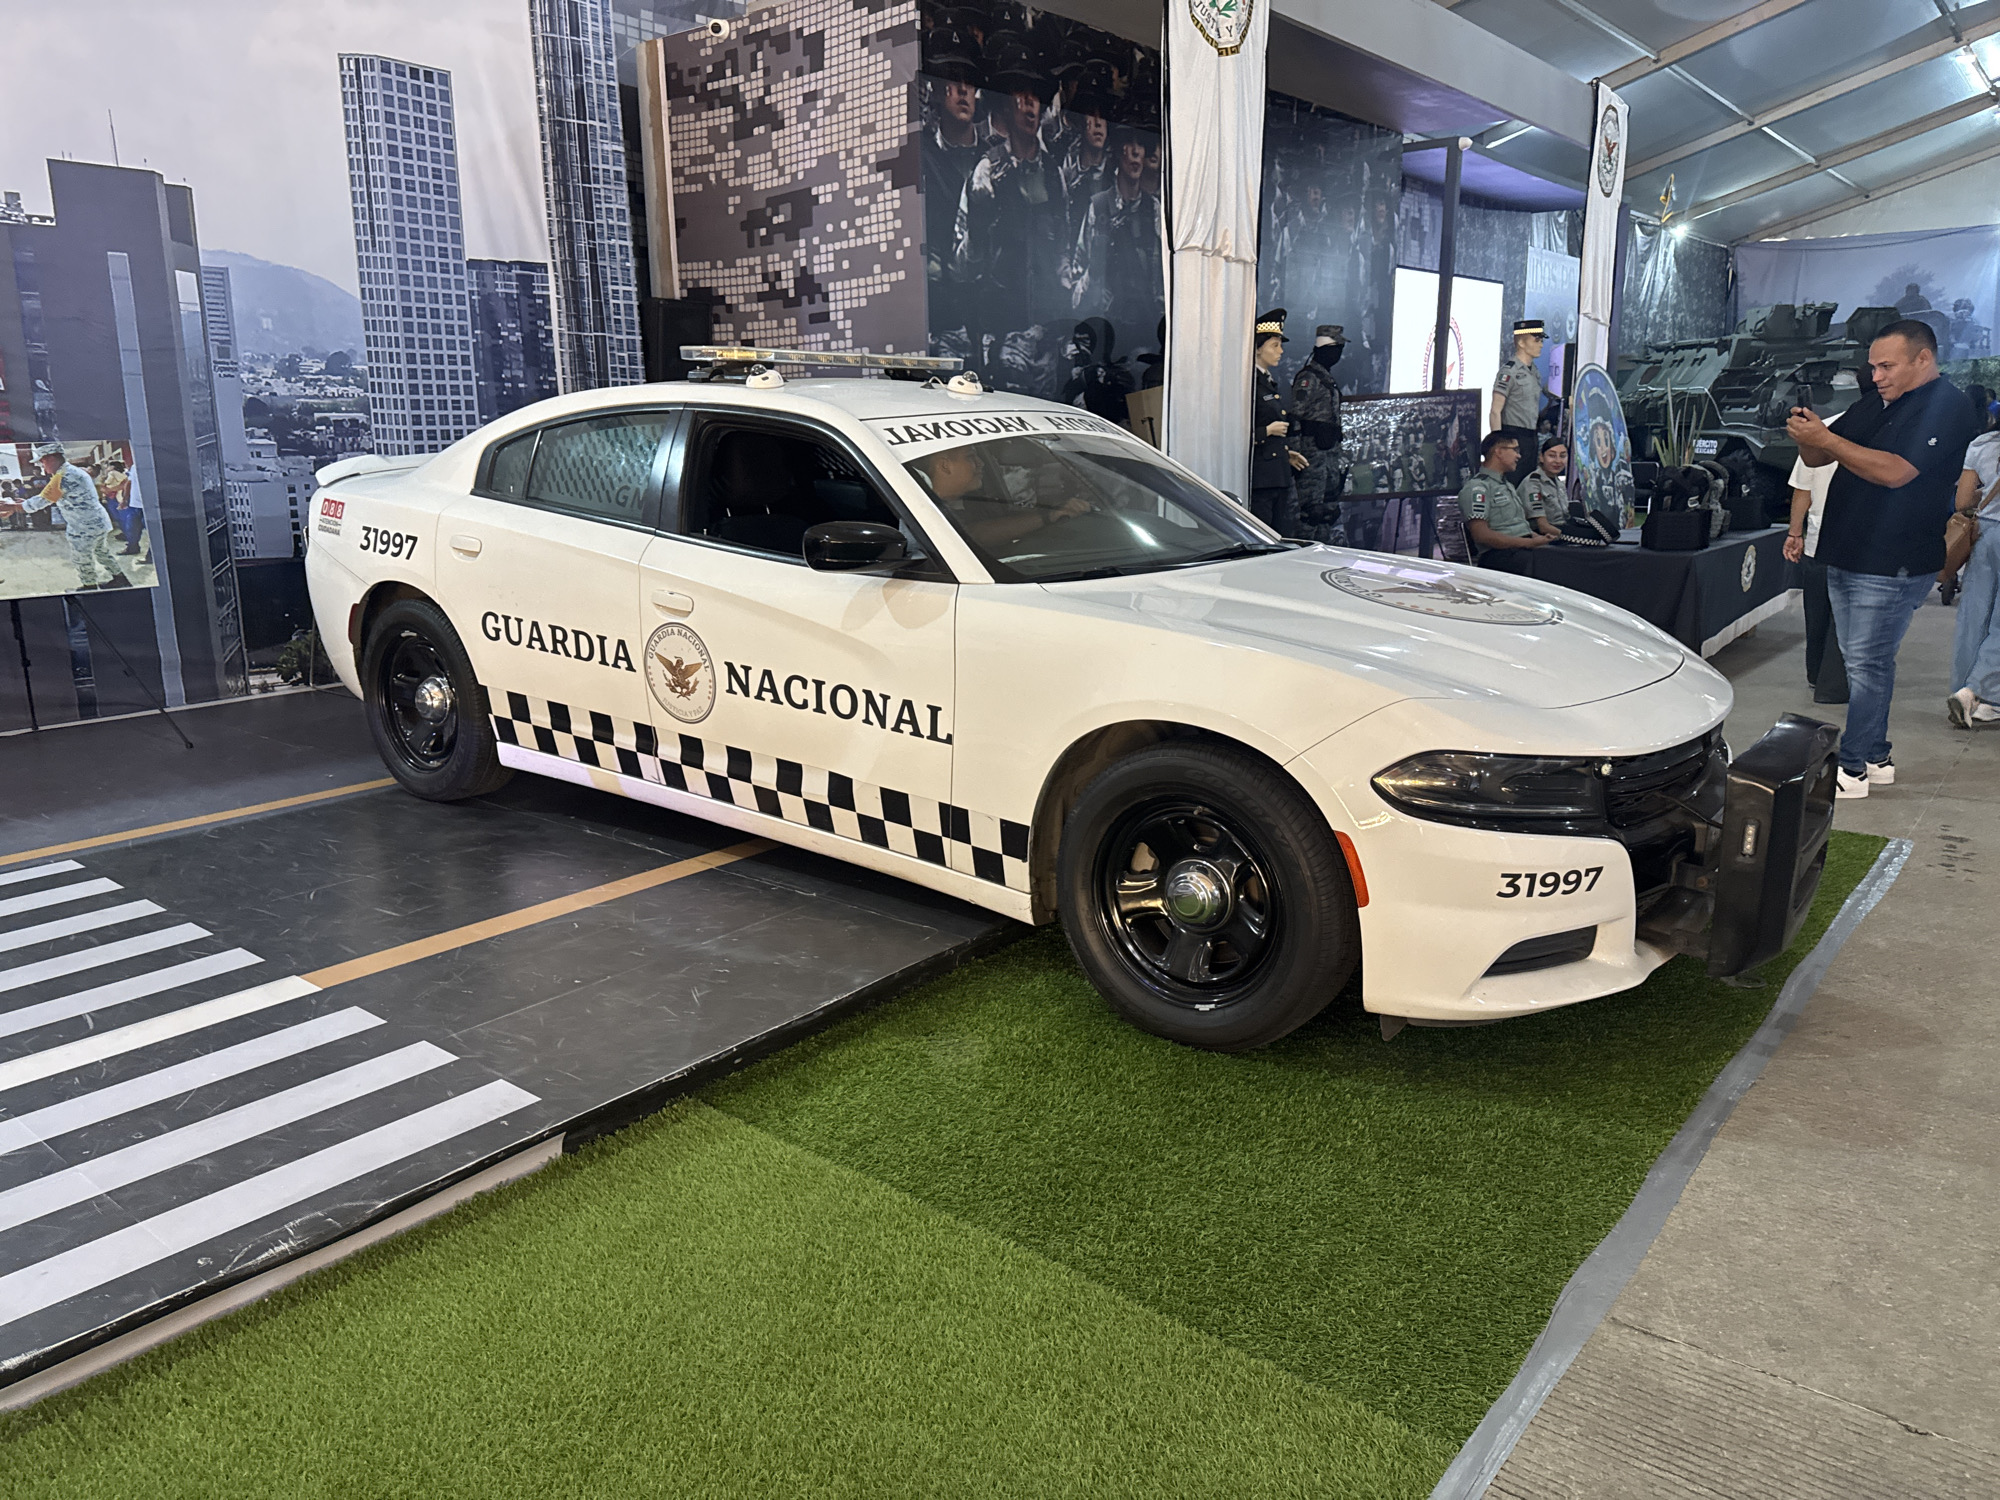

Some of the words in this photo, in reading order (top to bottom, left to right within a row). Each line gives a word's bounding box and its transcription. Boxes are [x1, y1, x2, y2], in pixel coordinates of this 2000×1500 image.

[322, 500, 343, 518] 088
[359, 525, 418, 560] 31997
[648, 628, 676, 660] GUARDIA
[676, 628, 710, 672] NACIONAL
[481, 611, 637, 673] GUARDIA
[724, 661, 953, 745] NACIONAL
[1496, 866, 1604, 898] 31997
